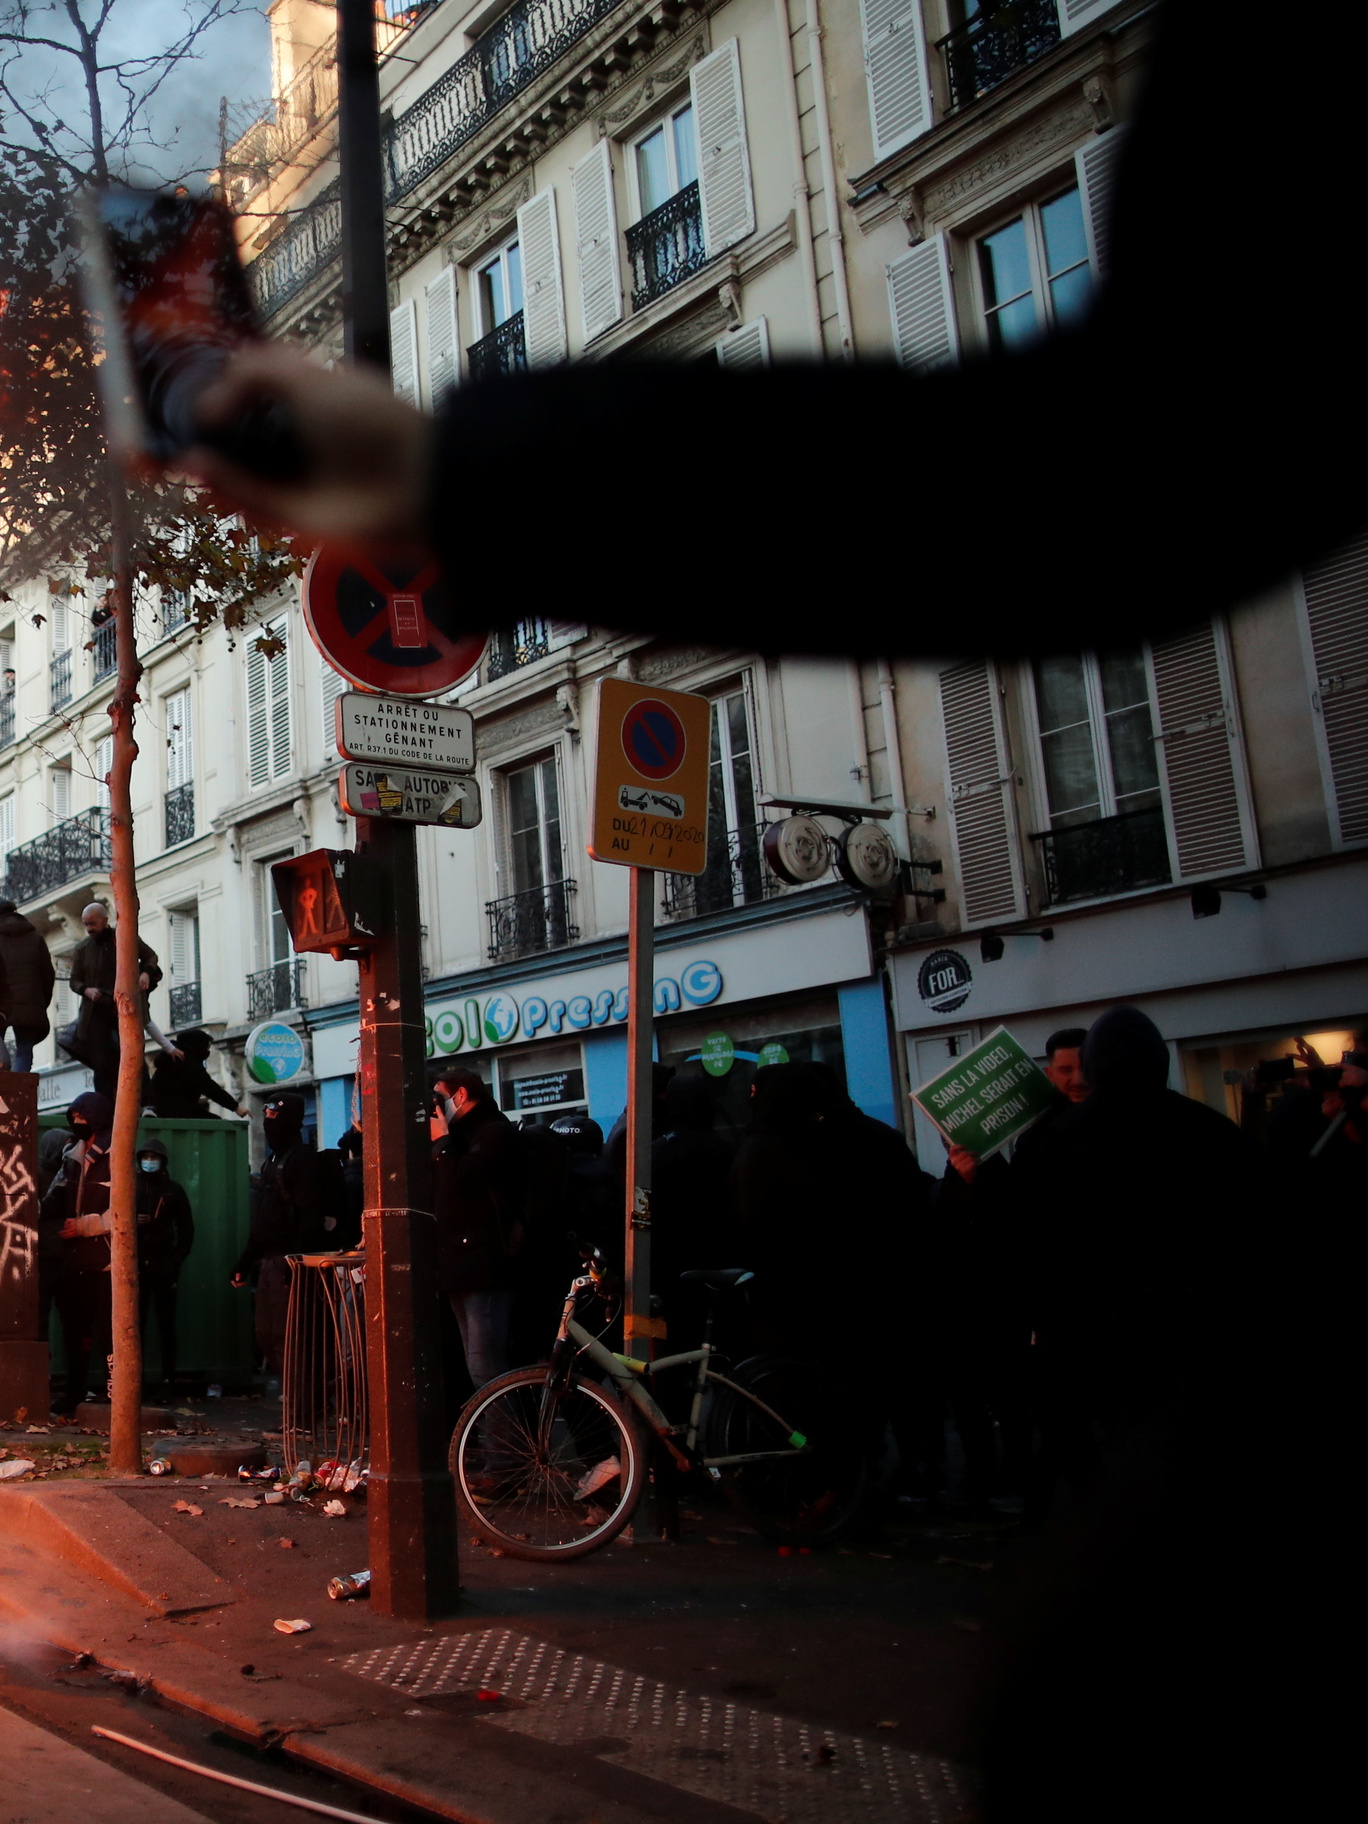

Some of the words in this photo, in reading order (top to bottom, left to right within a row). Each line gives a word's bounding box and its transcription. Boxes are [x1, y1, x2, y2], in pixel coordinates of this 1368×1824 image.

[377, 703, 418, 718] ARRÊT
[423, 710, 439, 721] OU
[354, 714, 462, 739] STATIONNEMENT
[385, 732, 433, 749] GÊNANT
[349, 743, 365, 752] ART.
[389, 748, 399, 756] DU
[401, 749, 420, 759] CODE
[423, 753, 432, 761] DE
[435, 754, 444, 762] LA
[446, 756, 469, 766] ROUTE
[400, 797, 431, 814] ATP
[613, 818, 631, 832] DU
[612, 838, 630, 851] AU
[38, 1079, 60, 1102] alle
[931, 1079, 965, 1109] SANS
[960, 1069, 980, 1087] LA
[941, 1097, 985, 1133] MICHEL
[979, 1069, 1020, 1104] SERAIT
[1014, 1058, 1034, 1077] EN
[979, 1098, 1024, 1135] PRISON
